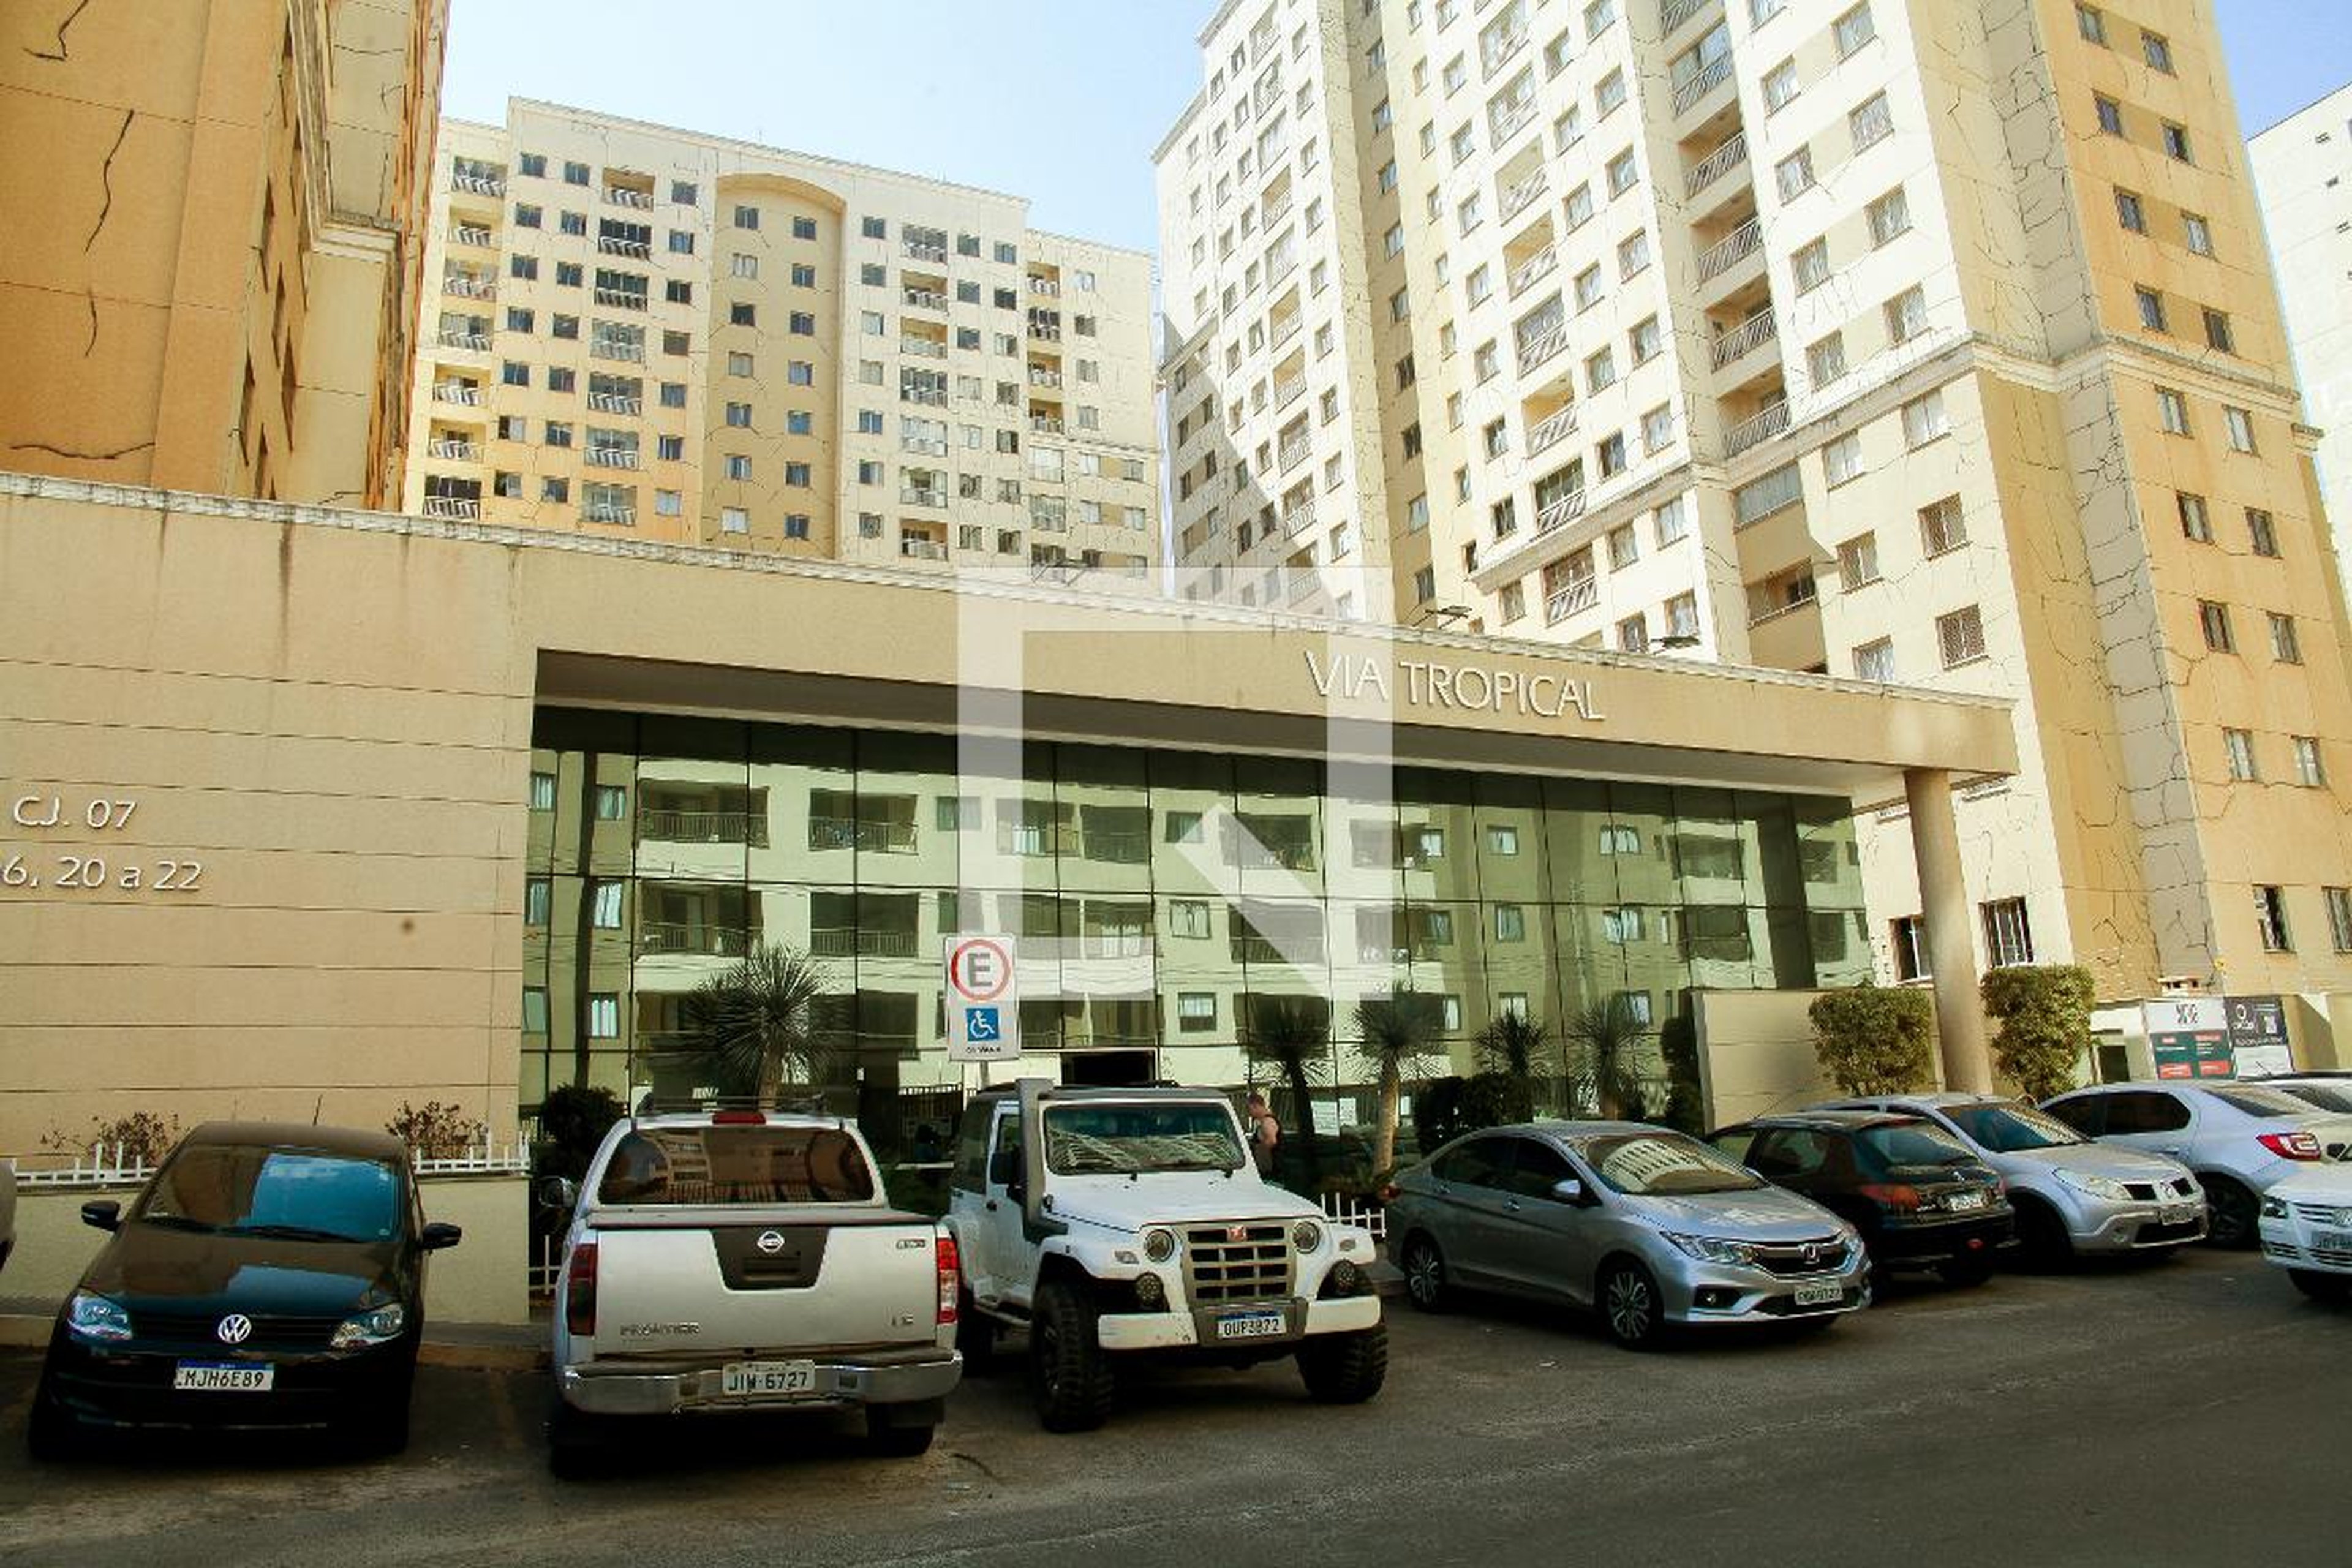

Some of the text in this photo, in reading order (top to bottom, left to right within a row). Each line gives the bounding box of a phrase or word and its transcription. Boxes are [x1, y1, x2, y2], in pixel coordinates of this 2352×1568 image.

[1304, 650, 1607, 722] VIA TROPICAL
[13, 796, 137, 828] CJ. 07
[55, 856, 106, 888] 20
[119, 866, 142, 888] a
[153, 861, 203, 891] 22
[968, 952, 992, 987] E
[184, 1370, 265, 1388] MJH6E89
